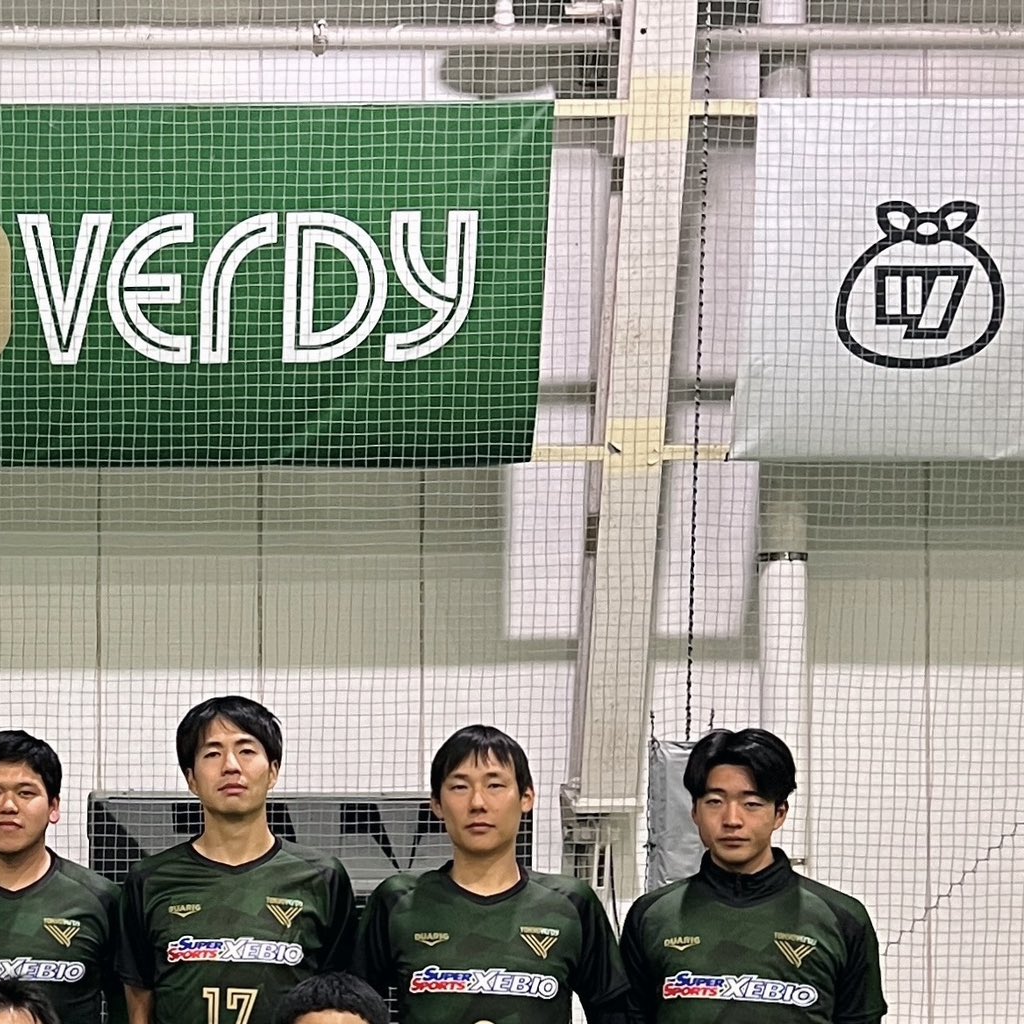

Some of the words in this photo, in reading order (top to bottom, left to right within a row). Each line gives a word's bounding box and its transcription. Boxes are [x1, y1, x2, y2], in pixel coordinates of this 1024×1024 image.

[178, 938, 223, 951] SUPER
[220, 939, 302, 964] XEBIO
[168, 949, 217, 961] SPORTS
[423, 969, 472, 981] SUPER
[675, 972, 725, 987] SUPER
[410, 979, 466, 992] SPORTS
[469, 970, 557, 998] XEBIO
[664, 984, 718, 998] SPORTS
[721, 975, 817, 1006] XEBIO
